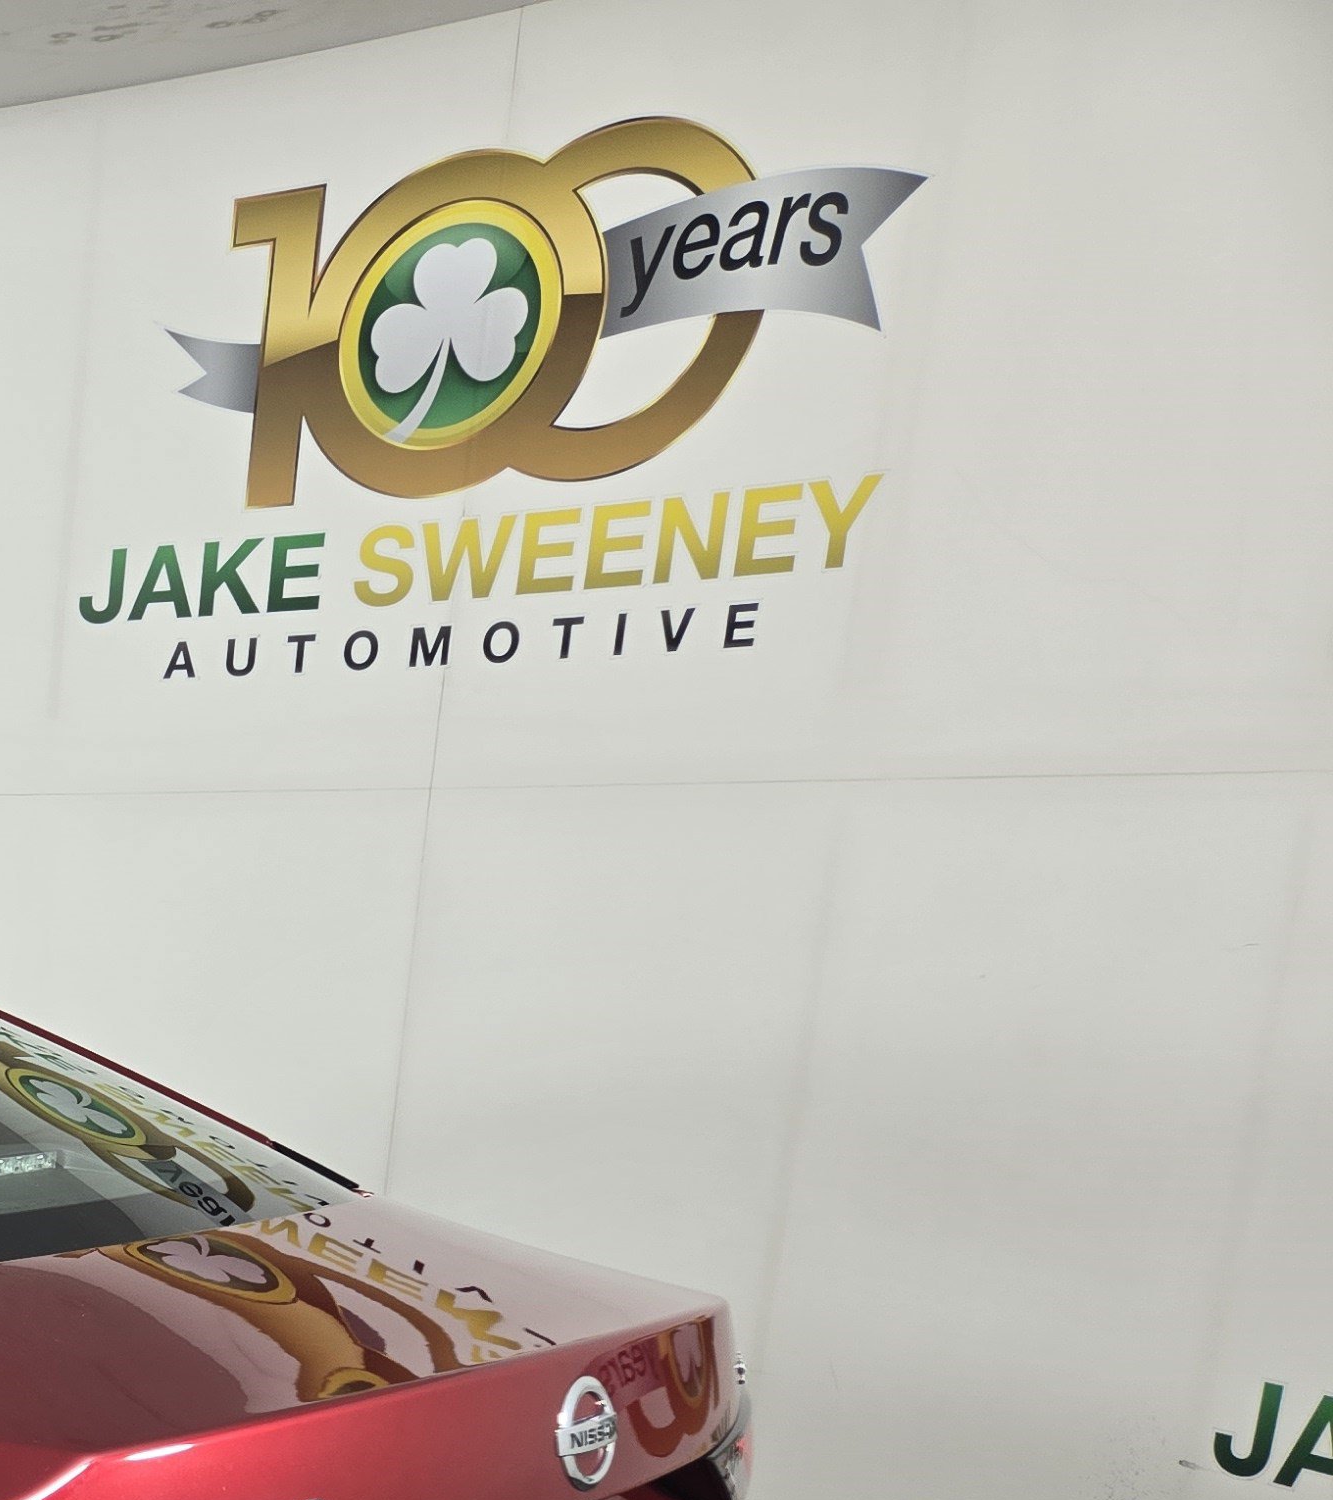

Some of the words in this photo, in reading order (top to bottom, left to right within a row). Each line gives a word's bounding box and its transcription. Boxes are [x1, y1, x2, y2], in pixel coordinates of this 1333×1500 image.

[619, 189, 850, 317] years
[78, 532, 326, 625] JAKE
[353, 473, 884, 608] SWEENEY
[163, 602, 761, 680] AUTOMOTIVE
